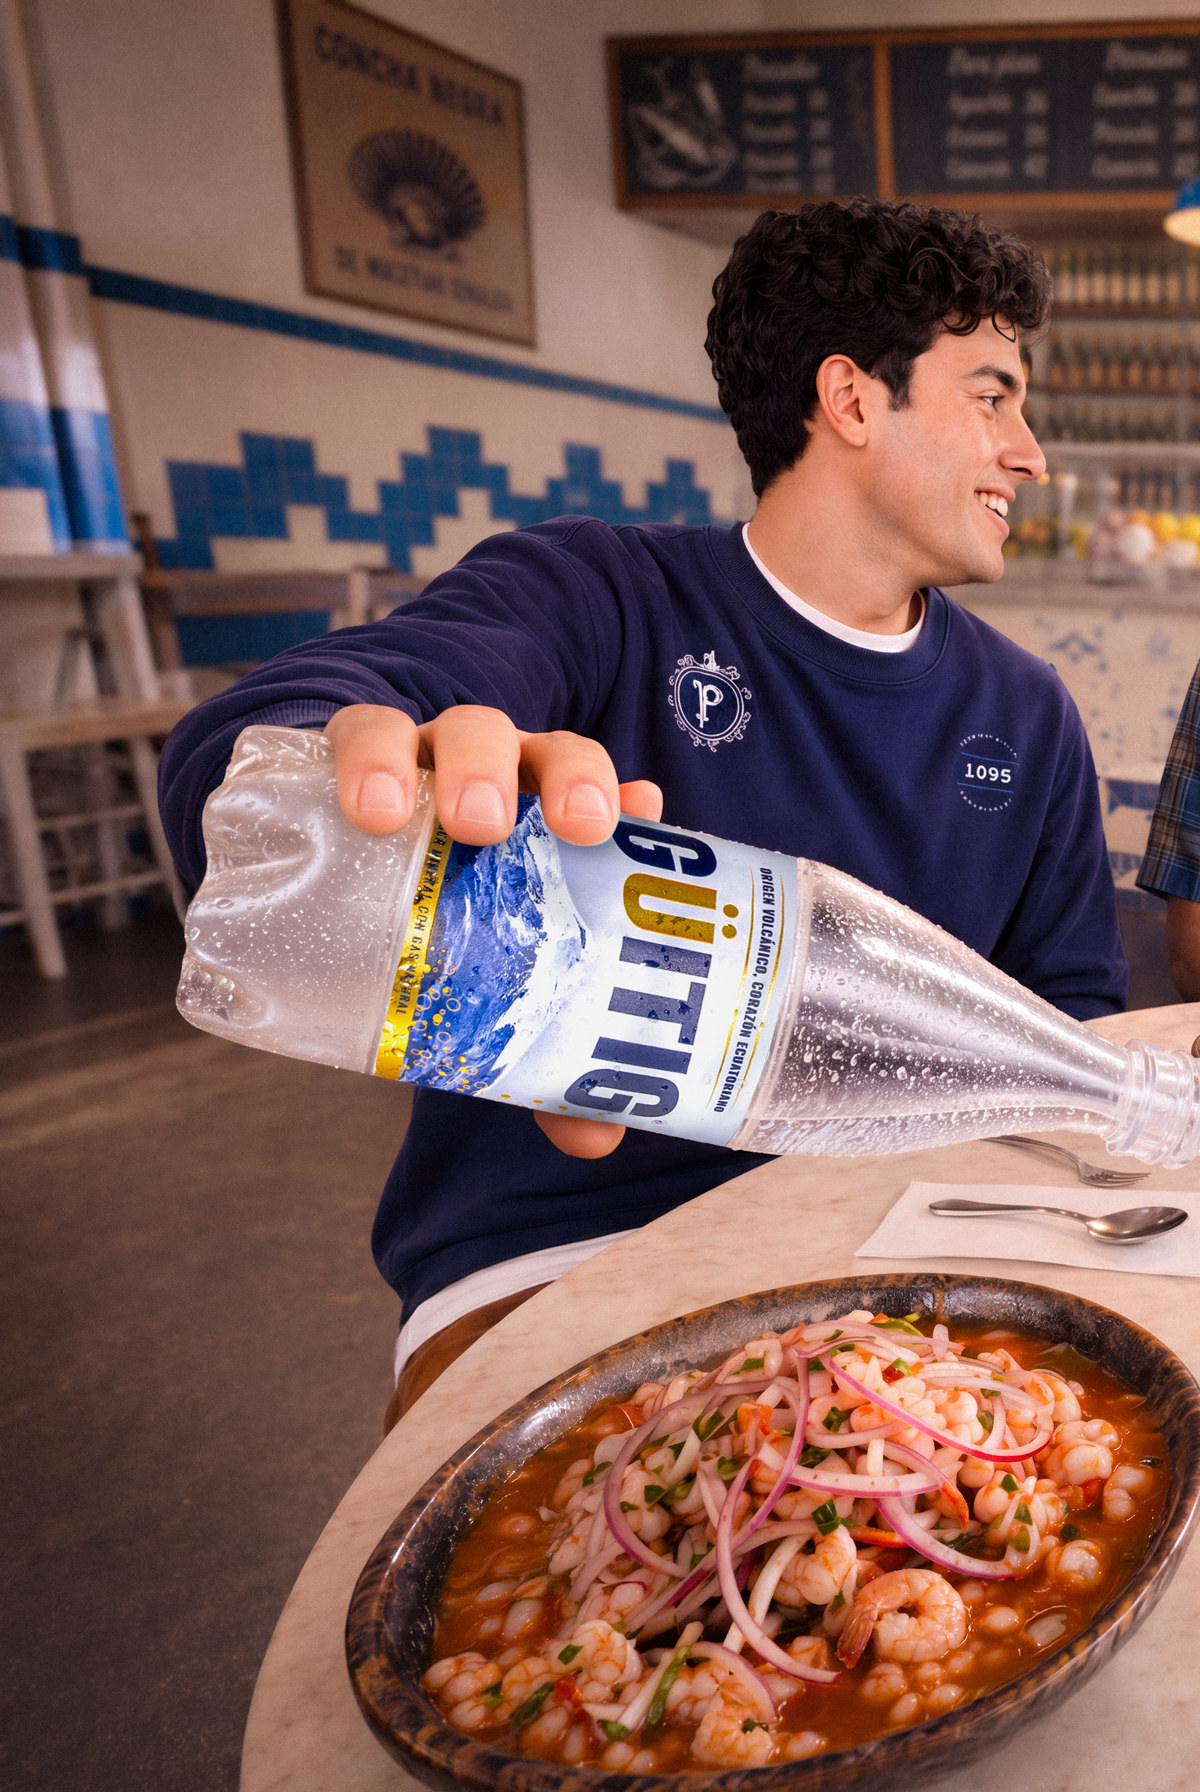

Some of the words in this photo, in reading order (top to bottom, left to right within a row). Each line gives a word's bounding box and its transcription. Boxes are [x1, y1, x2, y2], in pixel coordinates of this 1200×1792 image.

[314, 24, 420, 94] CONCHA
[429, 71, 504, 127] NEGRA
[964, 763, 1012, 783] 1095
[421, 848, 443, 901] MINERAL
[759, 867, 776, 906] ORIGEN
[414, 905, 430, 931] CON
[752, 909, 776, 977] VOLCÁNICO,
[409, 936, 423, 960] GAS
[564, 820, 738, 1118] GÜITIG
[395, 965, 417, 1015] NATURAL
[739, 981, 765, 1038] CORAZÓN
[713, 1041, 749, 1113] ECUATORIANO
